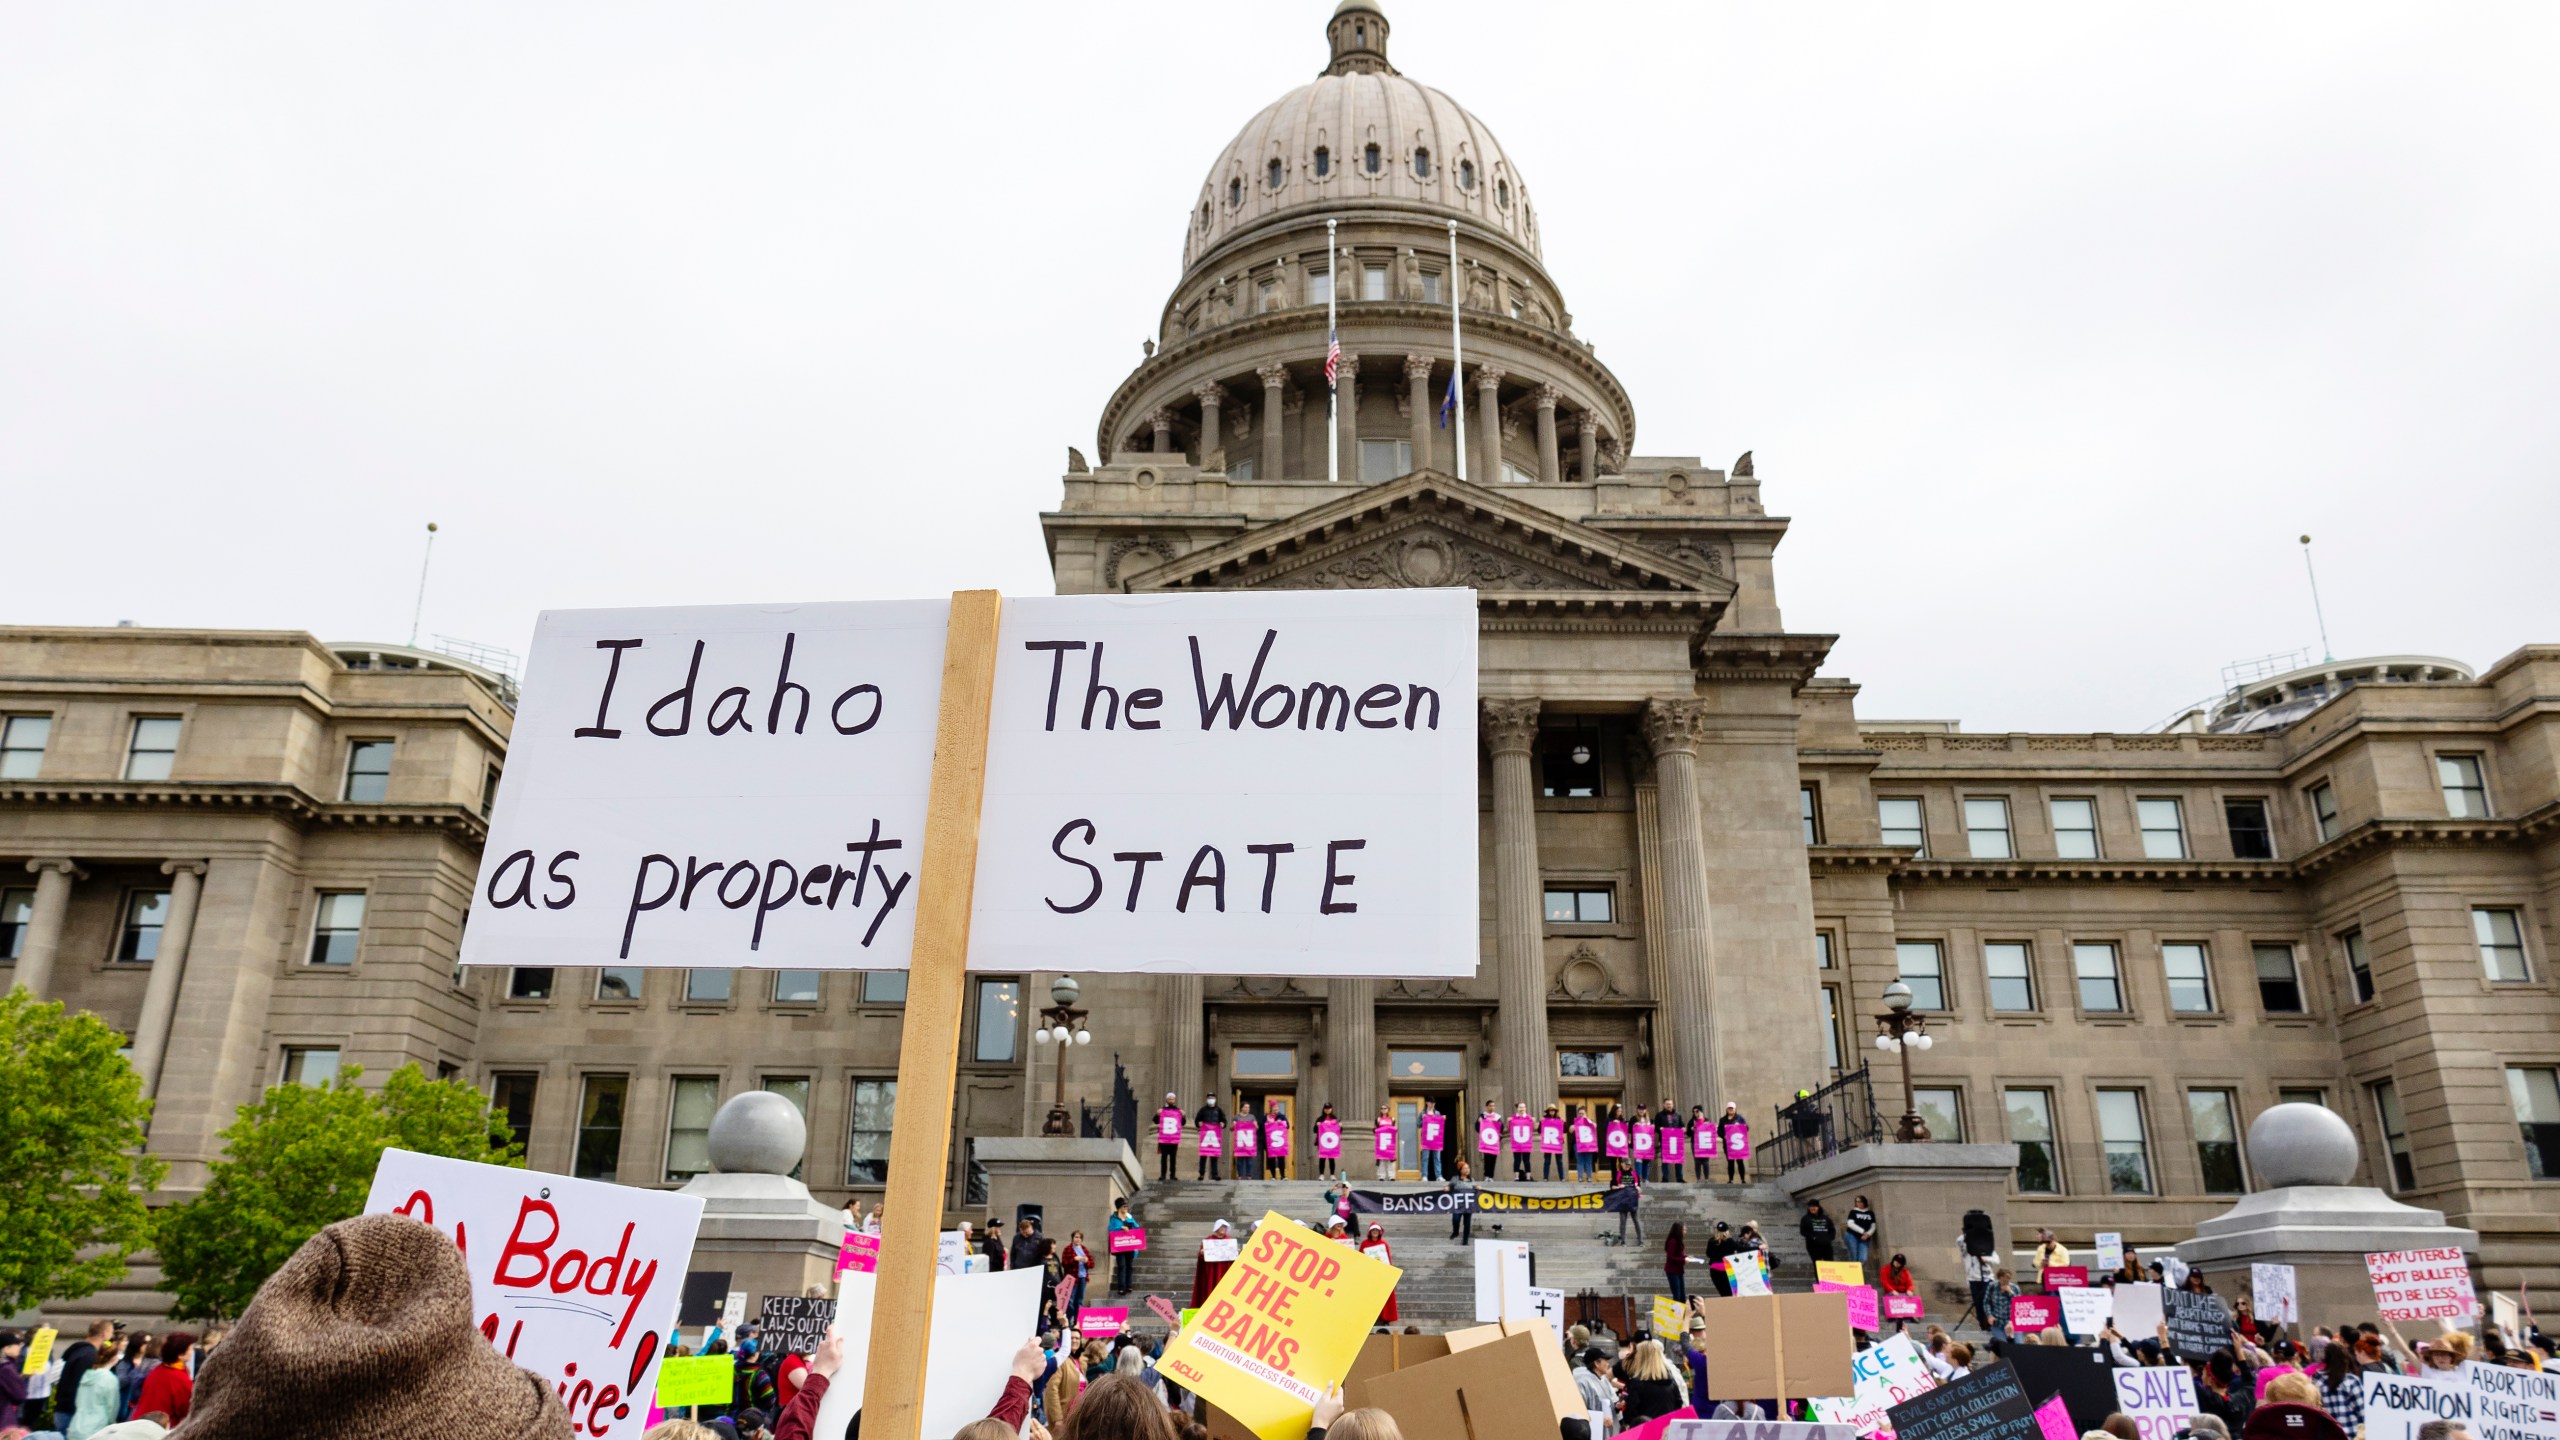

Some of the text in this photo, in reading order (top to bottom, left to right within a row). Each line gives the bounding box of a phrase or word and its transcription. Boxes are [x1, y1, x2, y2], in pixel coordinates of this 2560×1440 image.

[574, 629, 1440, 739] Idaho The Women
[487, 818, 1366, 959] as property STATE
[1382, 1192, 1604, 1211] BANS OFF OUR BODIES
[1252, 1229, 1341, 1298] STOP.
[2367, 1248, 2460, 1265] IF MY UTERUS
[493, 1195, 658, 1350] Body
[2370, 1266, 2469, 1285] SHOT BULLETS
[763, 1297, 802, 1316] KEEP
[1230, 1264, 1300, 1328] THE.
[2405, 1289, 2423, 1301] BE
[2425, 1287, 2457, 1300] LESS
[760, 1316, 796, 1332] LAWS
[2381, 1304, 2460, 1320] REGULATED
[760, 1332, 785, 1351] MY
[1202, 1299, 1300, 1378] BANS.
[1169, 1359, 1204, 1383] ACLU
[1194, 1336, 1316, 1402] ABORTION ACCESS FOR ALL
[2471, 1366, 2556, 1400] ABORTION
[1925, 1402, 1937, 1411] IS
[1936, 1389, 1956, 1406] NOT
[1957, 1381, 1978, 1397] ONE
[1980, 1368, 2011, 1389] LARGE
[1940, 1409, 1960, 1424] BUT
[1961, 1405, 1970, 1418] A
[1968, 1383, 2020, 1411] COLLECTION
[2119, 1370, 2194, 1409] SAVE
[2369, 1382, 2473, 1420] ABORTION
[1968, 1411, 2000, 1431] SMALL
[1998, 1424, 2008, 1436] UP
[2008, 1413, 2036, 1431] FROM
[2481, 1396, 2538, 1424] RIGHTS
